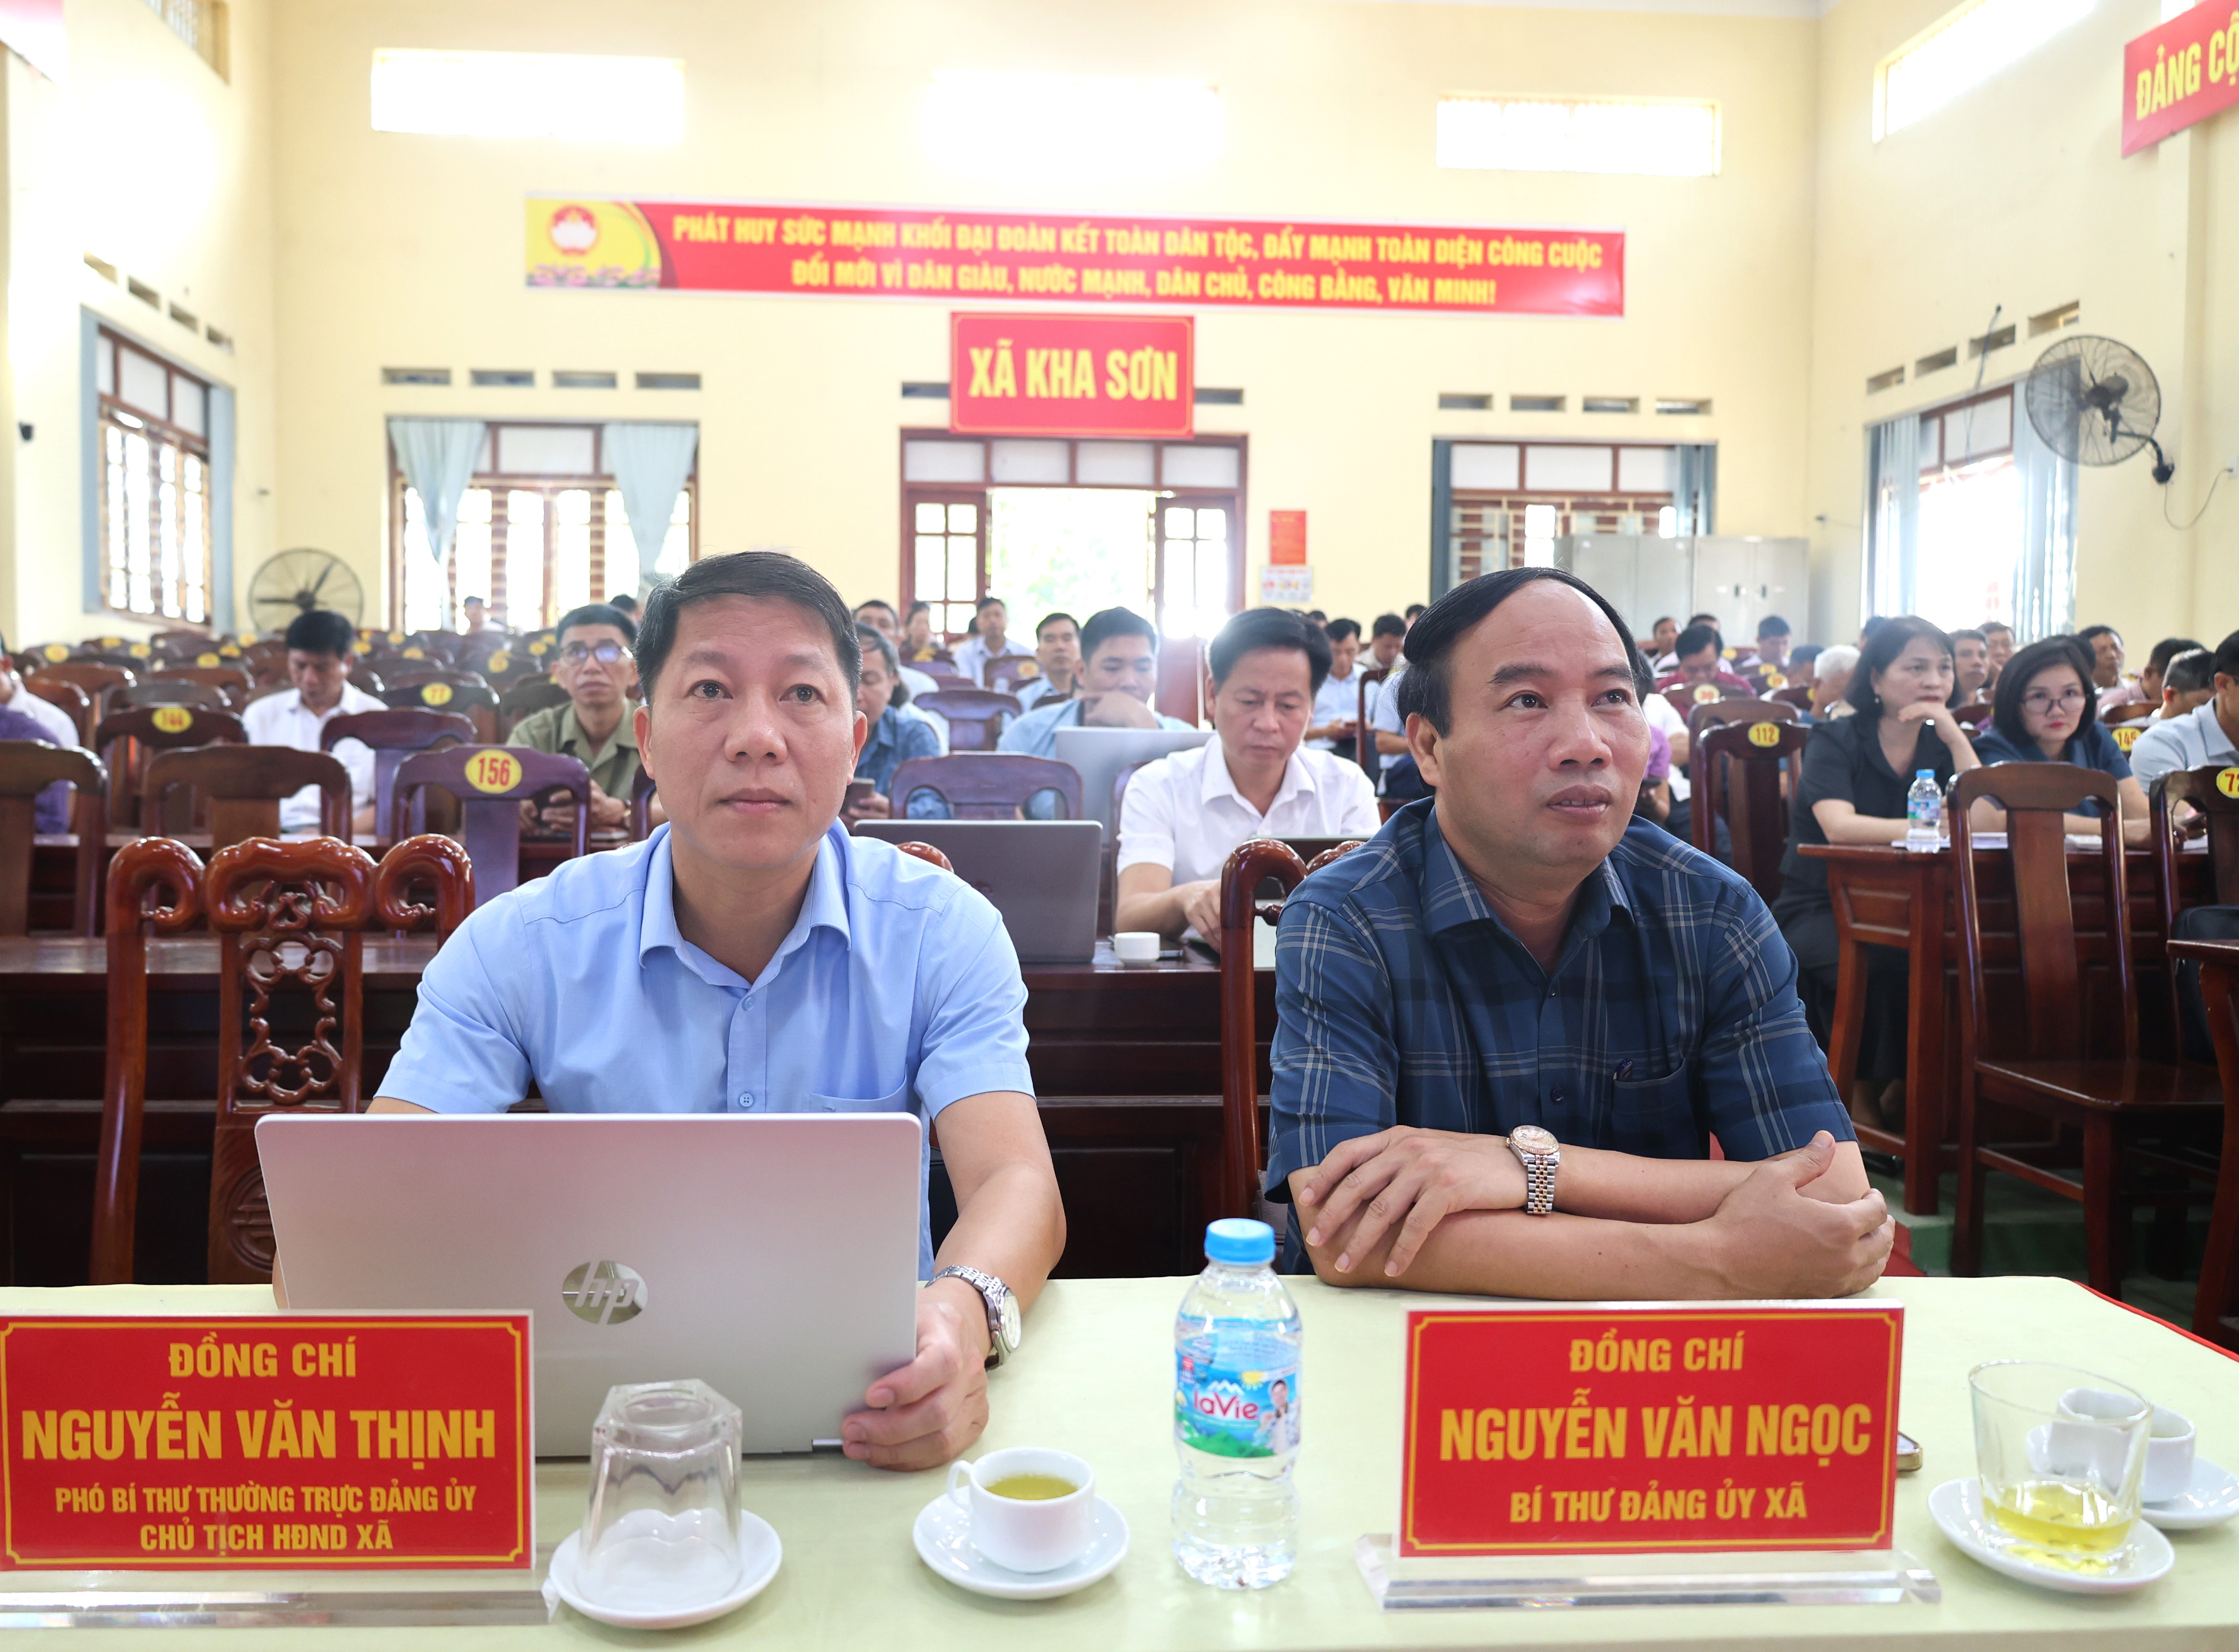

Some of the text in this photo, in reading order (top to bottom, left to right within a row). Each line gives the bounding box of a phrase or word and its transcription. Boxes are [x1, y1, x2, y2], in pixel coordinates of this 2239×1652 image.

[2136, 42, 2201, 121] ĐẢNG
[673, 211, 1603, 273] PHÁT HUY SỨC MẠNH KHỐI ĐẠI ĐOÀN KẾT TOÀN DÂN TỘC, ĐẨY MẠNH TOÀN DIỆN CÔNG CUỘC
[792, 250, 1497, 306] ĐỔI MỚI VÌ DÂN GIÀU, NƯỚC MẠNH, DÂN CHỦ, CÔNG BẰNG, VĂN MINH!
[968, 339, 1178, 401] XÃ KHA SƠN
[1756, 727, 1776, 743] 112
[478, 757, 511, 786] 156
[572, 1260, 641, 1324] hp
[169, 1332, 356, 1378] ĐỒNG CHÍ
[1569, 1327, 1746, 1372] ĐỒNG CHÍ
[22, 1391, 495, 1470] NGUYỄN VĂN THỊNH
[1440, 1387, 1872, 1467] NGUYỄN VĂN NGỌC
[55, 1477, 477, 1518] PHÓ BÍ THƯ THƯỜNG TRỰC ĐẢNG ỦY
[1510, 1478, 1807, 1523] BÍ THƯ ĐẢNG ỦY XÃ
[140, 1516, 394, 1557] CHỦ TỊCH HĐND XÃ
